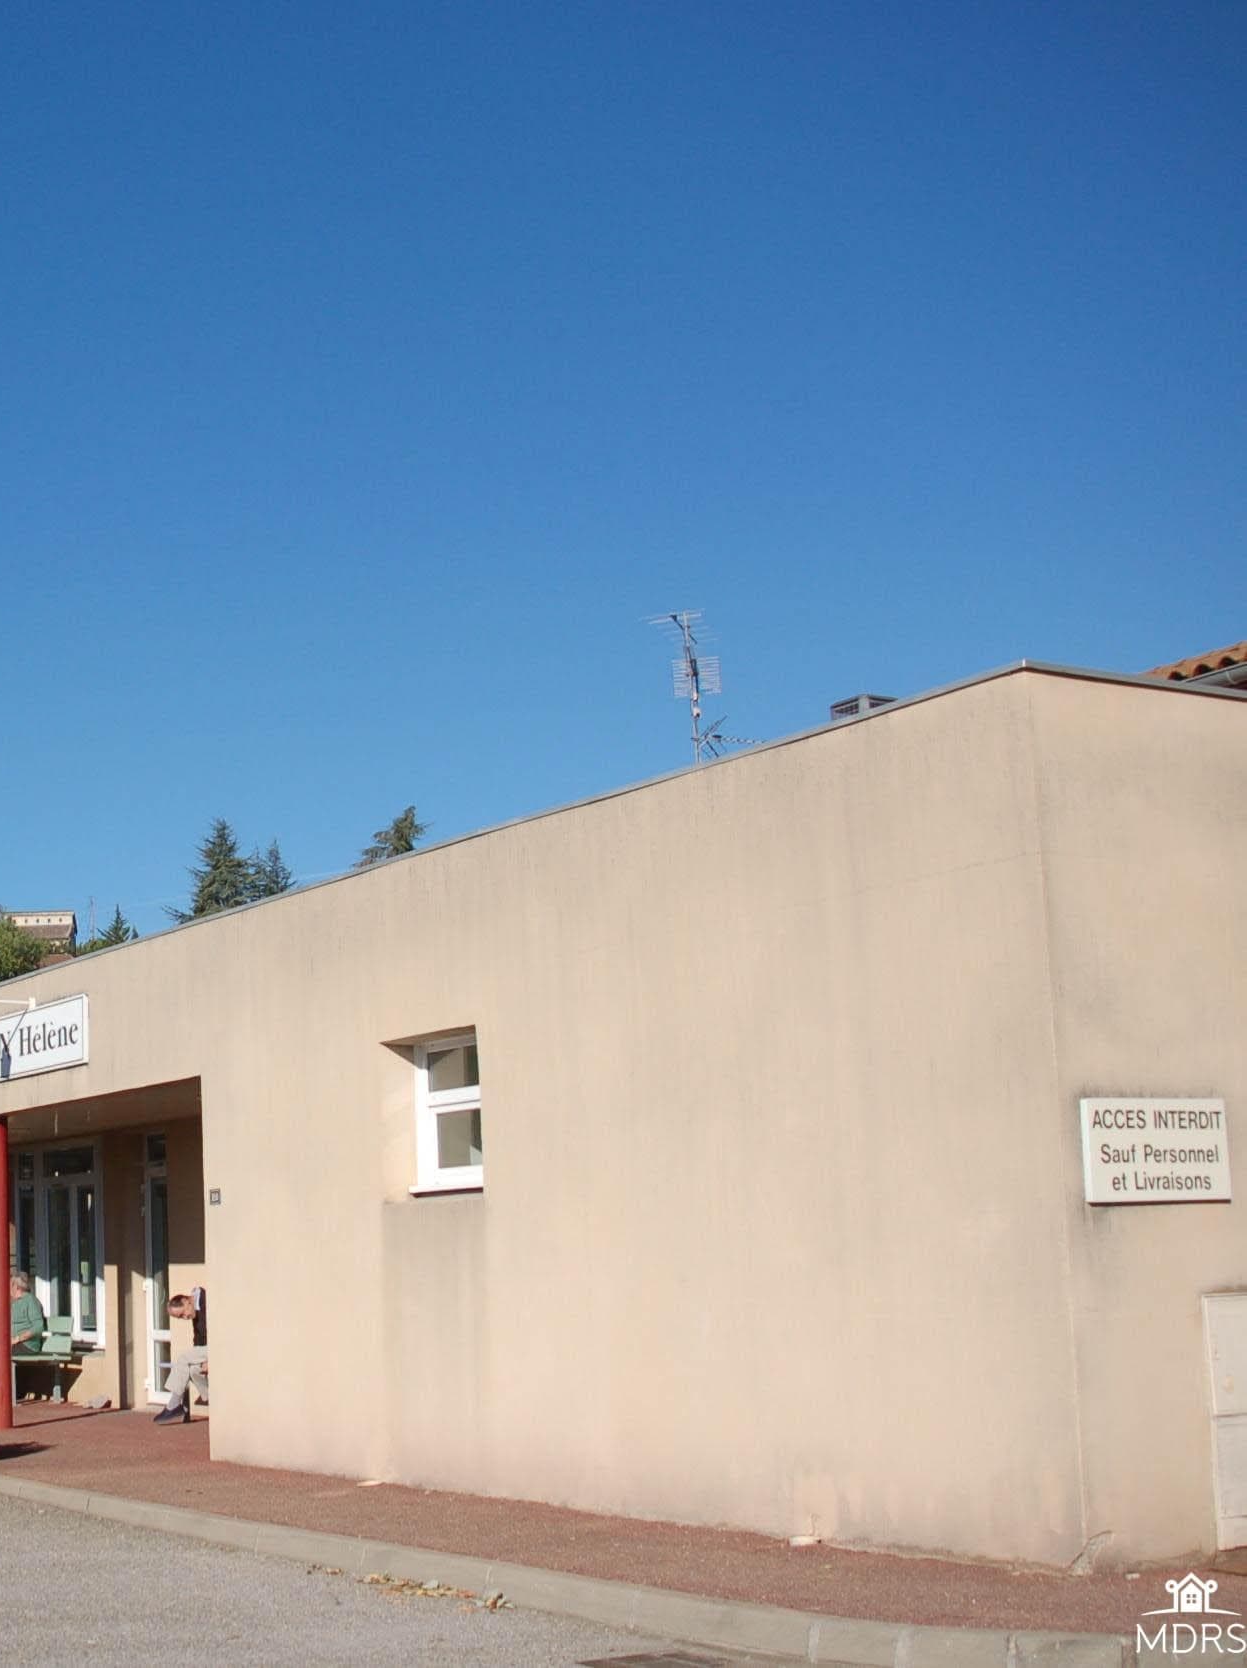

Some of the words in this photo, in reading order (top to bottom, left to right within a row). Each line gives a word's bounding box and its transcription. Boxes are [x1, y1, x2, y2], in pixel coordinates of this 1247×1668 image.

[19, 1021, 79, 1057] Hélène
[1092, 1109, 1147, 1129] ACCES
[1154, 1110, 1222, 1130] INTERDIT
[1100, 1143, 1136, 1164] Sauf
[1144, 1144, 1219, 1163] Personnel
[1112, 1173, 1127, 1191] et
[1134, 1171, 1212, 1190] Livraisons
